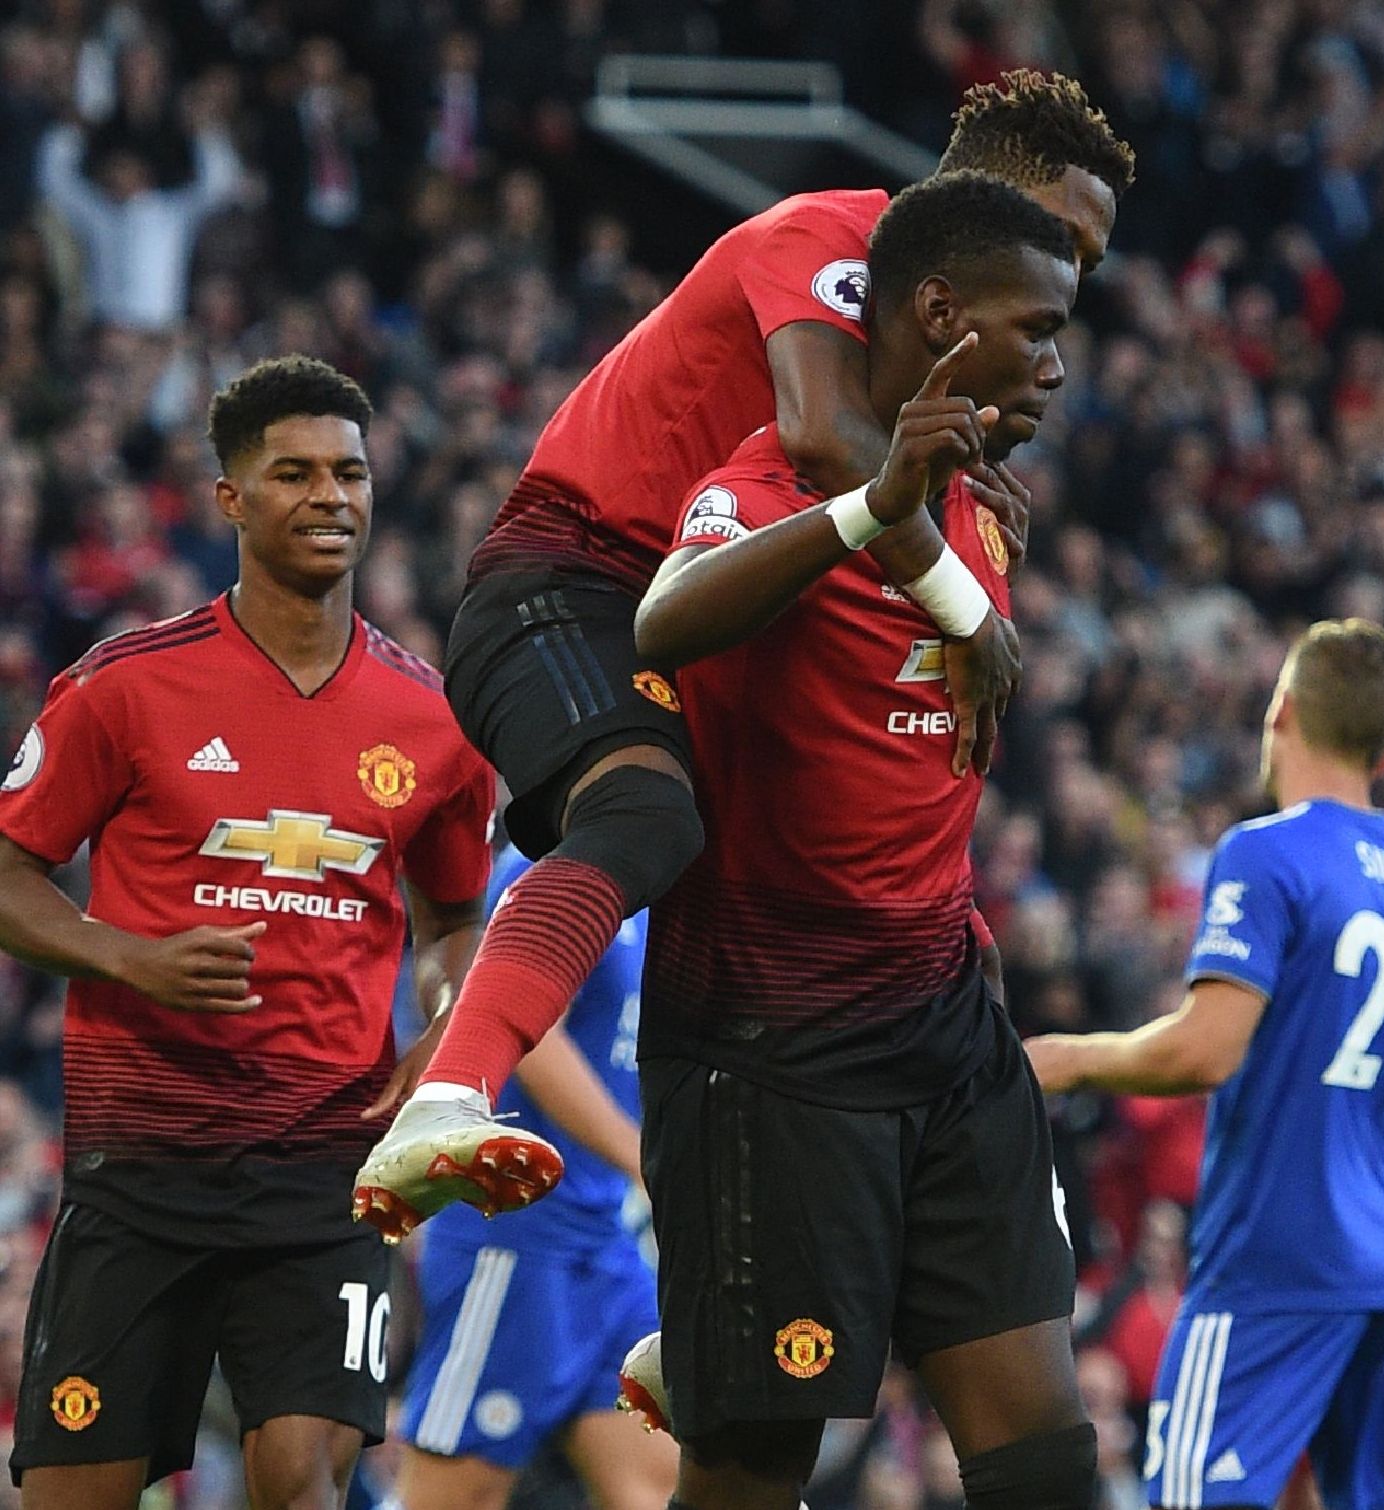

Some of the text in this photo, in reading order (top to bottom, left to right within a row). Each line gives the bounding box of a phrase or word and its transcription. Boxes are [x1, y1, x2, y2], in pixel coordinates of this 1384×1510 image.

[887, 711, 957, 735] CHEV
[194, 884, 369, 923] CHEVROLET
[338, 1282, 391, 1383] 10
